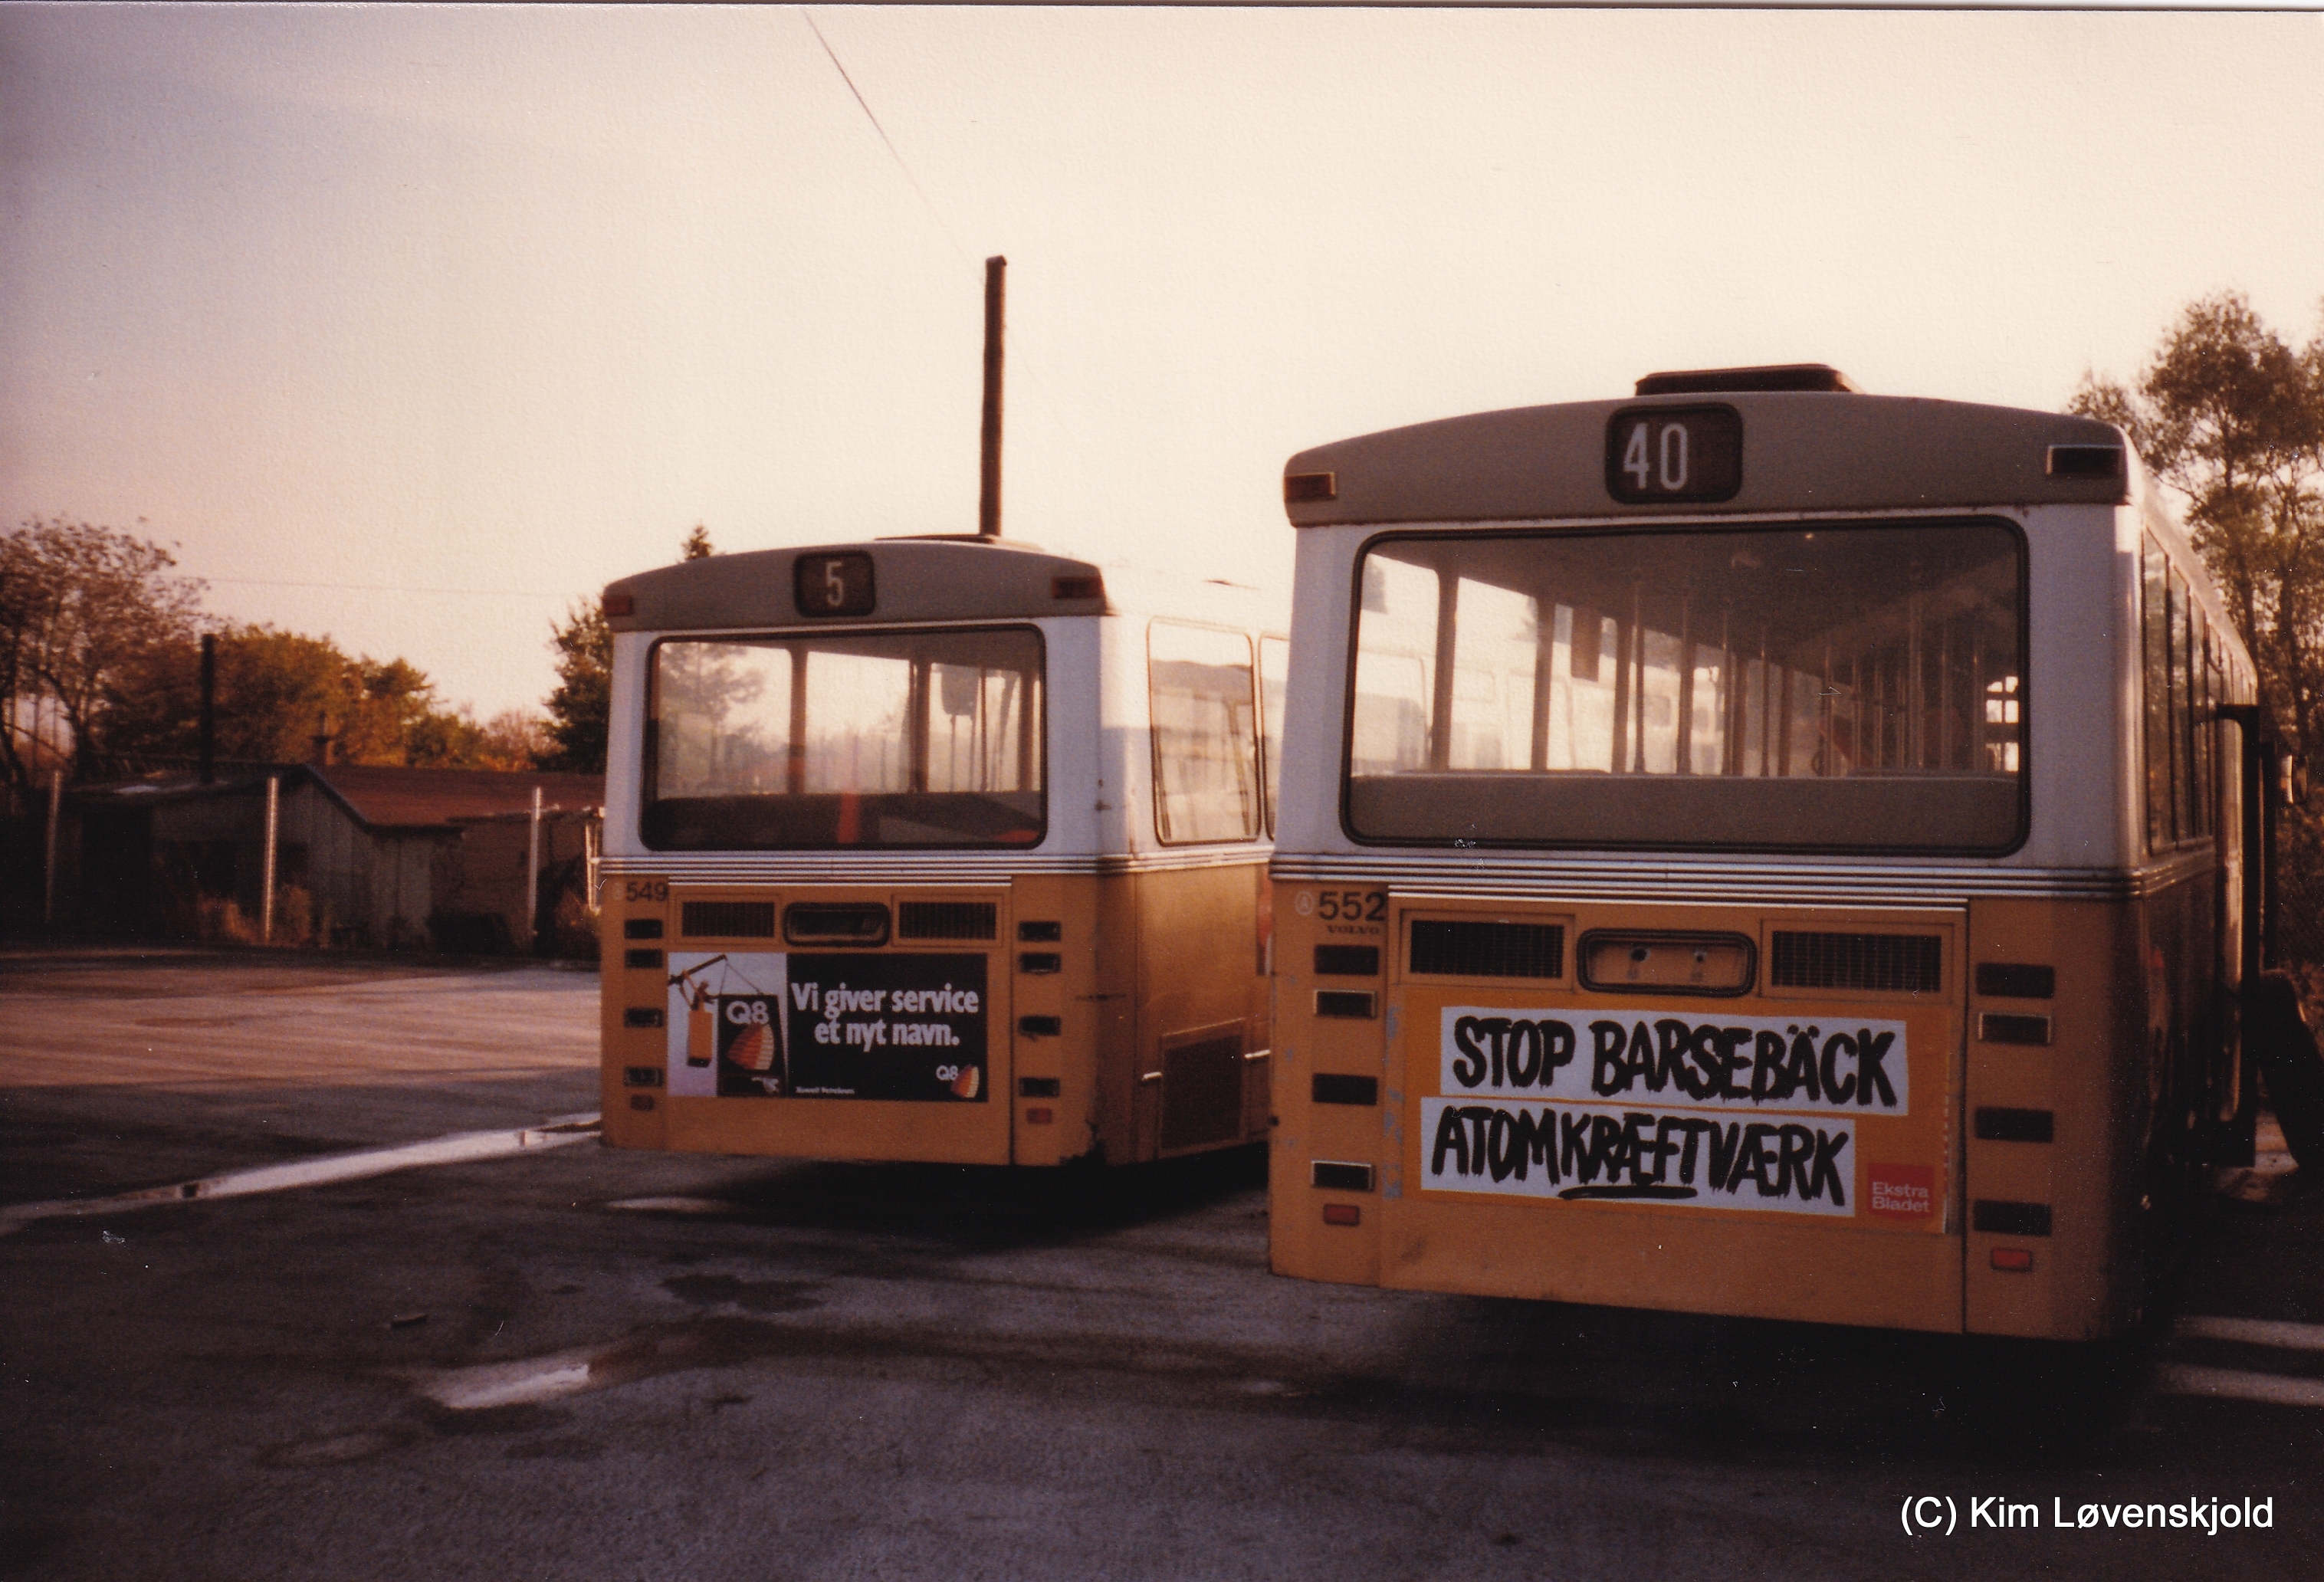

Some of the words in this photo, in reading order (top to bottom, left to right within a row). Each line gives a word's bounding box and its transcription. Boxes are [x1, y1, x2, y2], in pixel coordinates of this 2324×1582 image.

[1623, 422, 1689, 491] 40
[826, 561, 843, 607] 5
[626, 881, 669, 902] 549
[1318, 891, 1386, 922] 552
[725, 999, 770, 1026] Q8
[790, 982, 819, 1013] Vi
[823, 982, 887, 1019] giver
[891, 983, 980, 1013] service
[814, 1019, 841, 1045] et
[846, 1019, 886, 1053] nyt
[892, 1023, 960, 1046] navn.
[935, 1065, 960, 1081] Q8
[1453, 1015, 1576, 1089] STOP
[1588, 1019, 1897, 1108] BARSEBÄCK
[1430, 1105, 1850, 1207] ATOMKRÆFTVÆRK
[1872, 1181, 1929, 1198] Ekstra
[1872, 1196, 1930, 1213] Bladet
